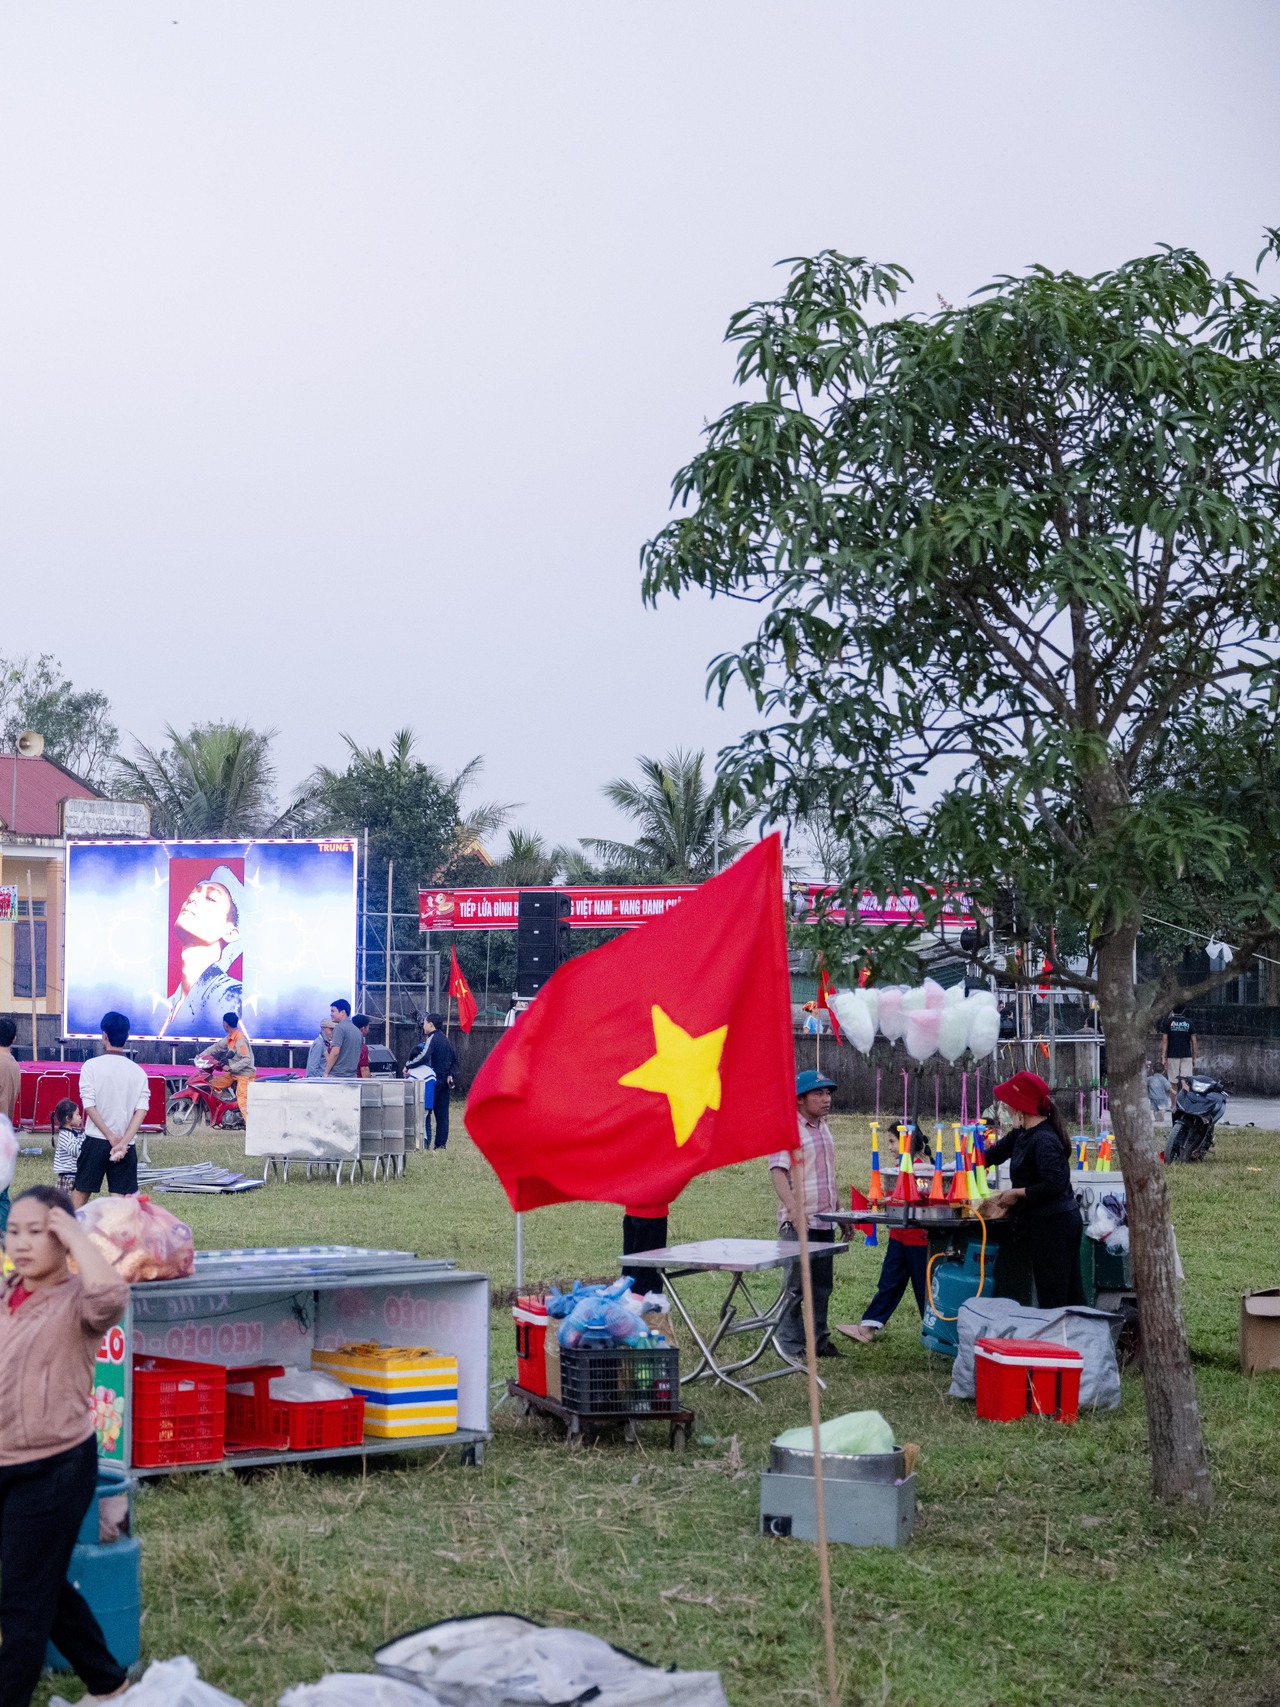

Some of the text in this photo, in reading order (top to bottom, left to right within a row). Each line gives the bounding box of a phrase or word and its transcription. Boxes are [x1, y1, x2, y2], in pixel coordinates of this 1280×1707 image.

[318, 844, 348, 852] TRUNG
[459, 897, 476, 917] TIẾP
[477, 897, 493, 917] LỬA
[493, 898, 513, 917] ĐÌNH
[575, 897, 593, 919] VIỆT
[593, 900, 613, 915] NAM
[620, 899, 641, 915] VANG
[642, 899, 664, 915] DANH
